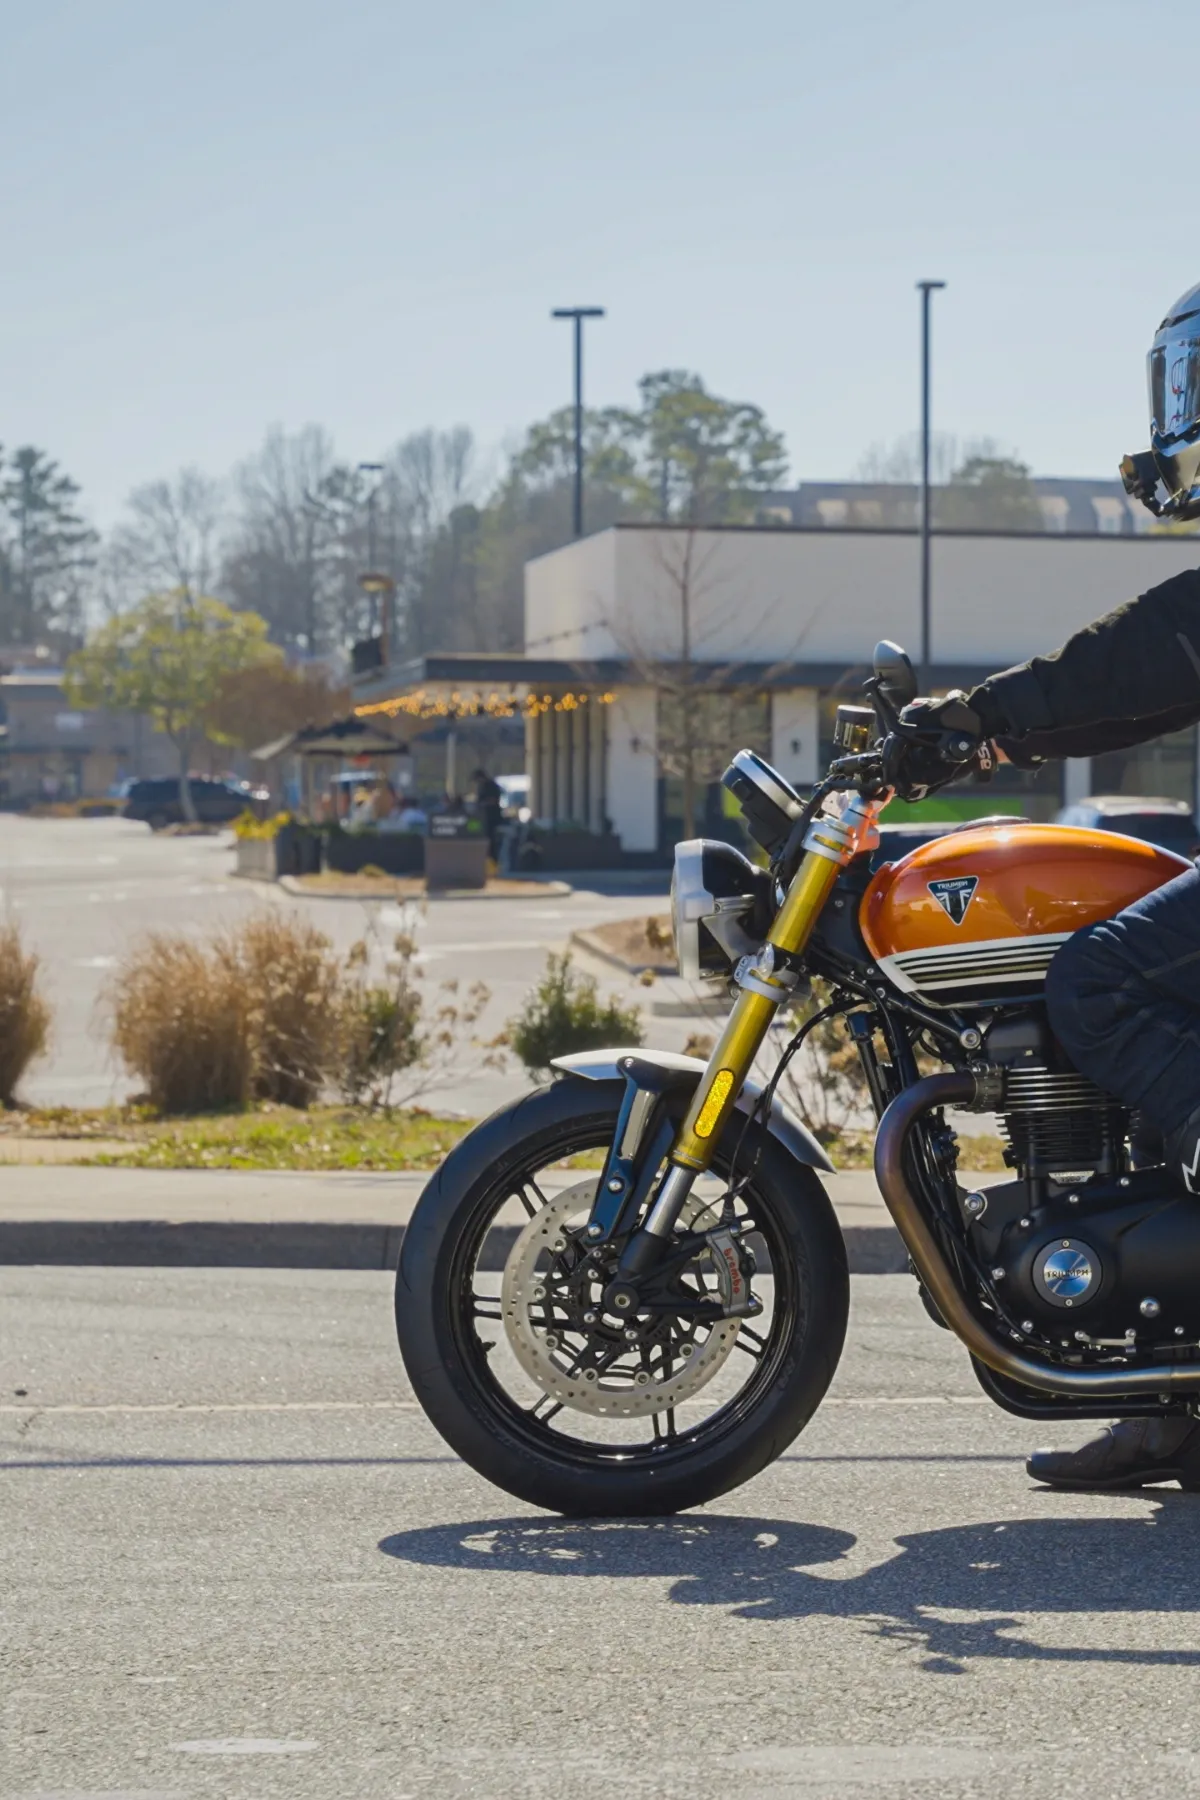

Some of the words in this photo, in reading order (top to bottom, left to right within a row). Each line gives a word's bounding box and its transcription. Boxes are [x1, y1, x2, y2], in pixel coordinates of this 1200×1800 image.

[937, 881, 968, 890] TRIUMPH
[723, 1247, 742, 1295] brembo
[1047, 1269, 1089, 1279] TRIUMPH
